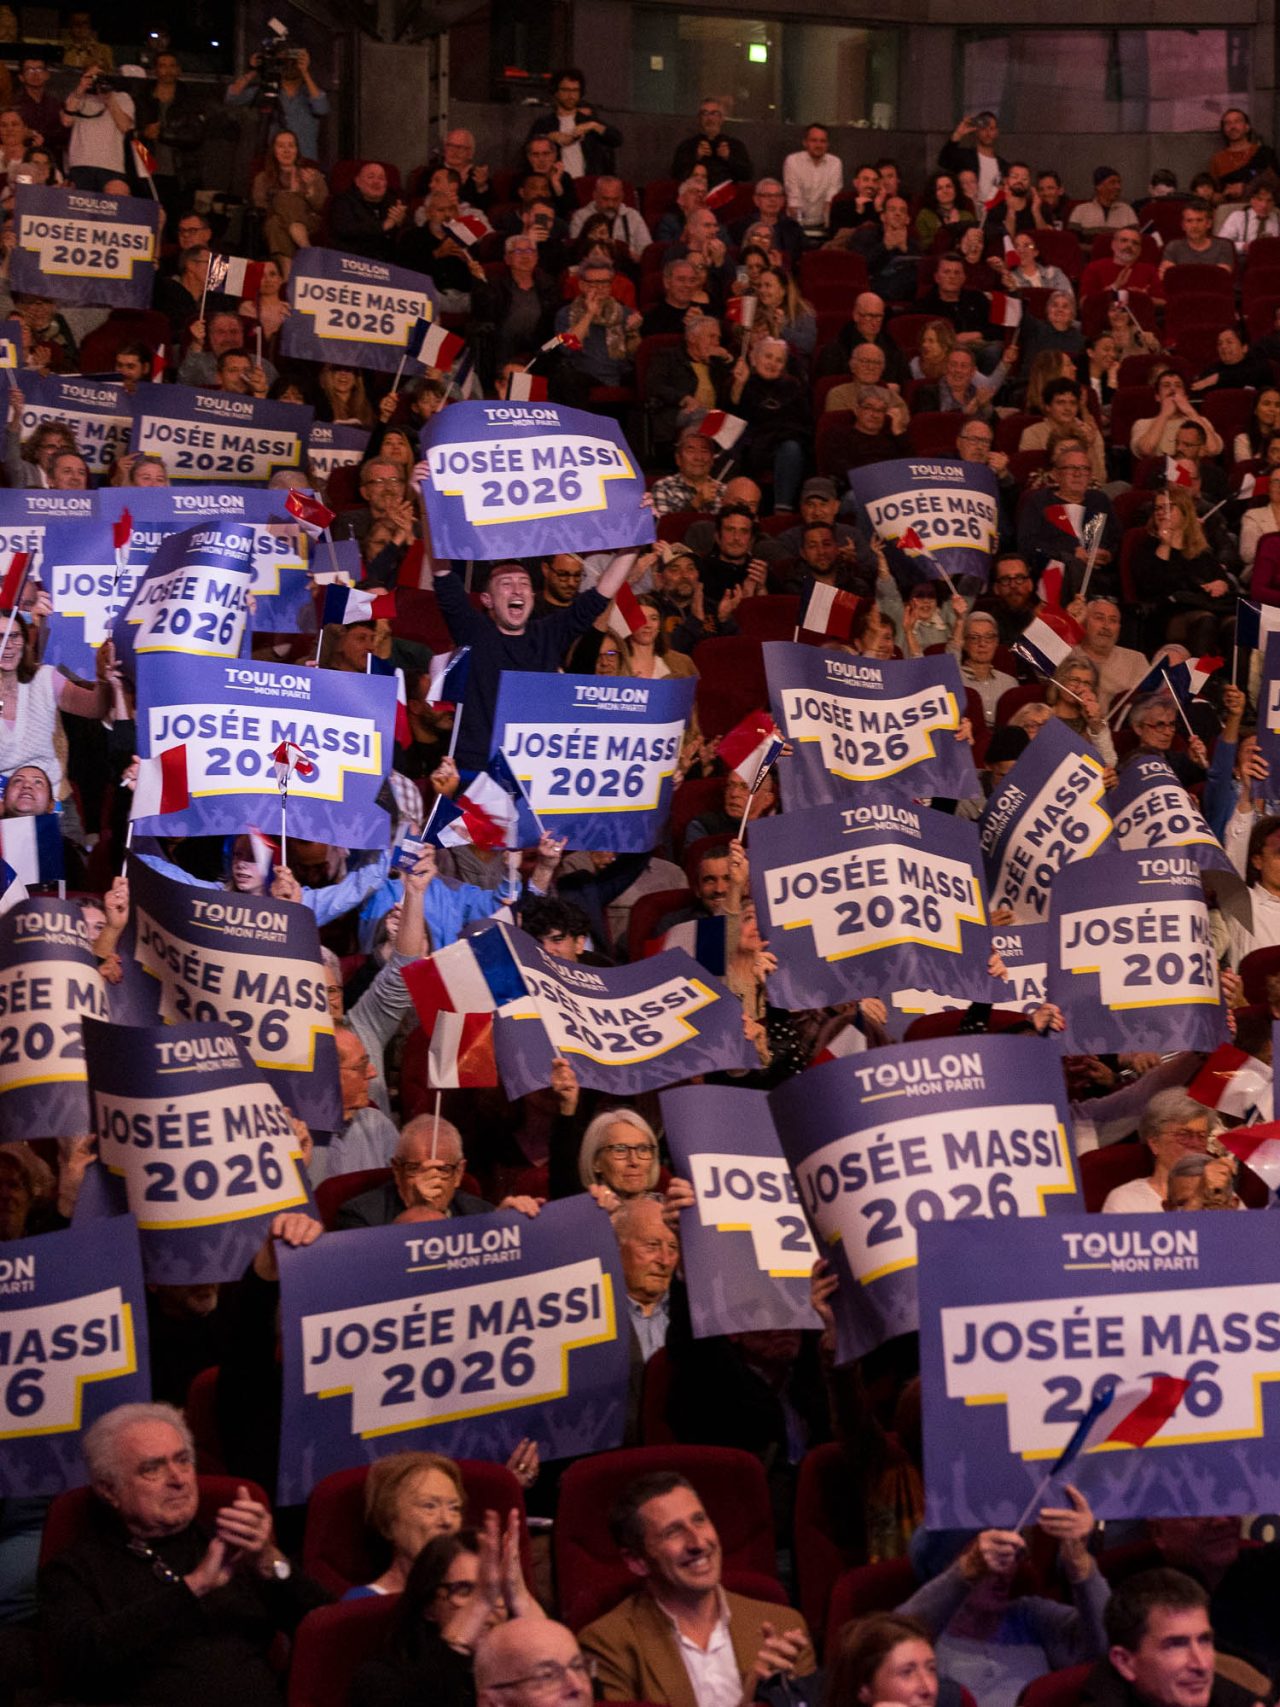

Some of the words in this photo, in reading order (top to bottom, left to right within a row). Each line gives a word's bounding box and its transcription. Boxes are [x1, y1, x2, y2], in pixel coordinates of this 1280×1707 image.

[23, 221, 87, 243] JOSÉE
[92, 227, 149, 250] MASSI
[53, 246, 119, 269] 2026
[341, 259, 390, 275] TOULON
[299, 282, 360, 306] JOSÉE
[366, 289, 426, 317] MASSI
[328, 309, 395, 334] 2026
[61, 384, 117, 401] TOULON
[195, 396, 254, 414] TOULON
[484, 408, 558, 421] TOULON
[144, 423, 214, 448] JOSÉE
[222, 434, 293, 457] MASSI
[176, 451, 255, 473] 2026
[435, 444, 523, 475] JOSÉE
[533, 447, 622, 471] MASSI
[908, 465, 964, 477] TOULON
[26, 497, 92, 511] TOULON
[172, 495, 244, 510] TOULON
[481, 470, 582, 507] 2026
[874, 492, 943, 526] JOSÉE
[911, 517, 981, 540] 2026
[138, 570, 198, 604] JOSÉE
[150, 607, 235, 645] 2026
[224, 668, 311, 692] TOULON
[825, 660, 883, 682] TOULON
[254, 686, 280, 697] MON
[574, 685, 649, 704] TOULON
[790, 697, 853, 732] JOSÉE
[860, 697, 948, 735] MASSI
[155, 709, 260, 742] JOSÉE
[271, 719, 370, 758] MASSI
[508, 727, 598, 759] JOSÉE
[832, 733, 909, 767] 2026
[549, 764, 644, 797] 2026
[840, 803, 920, 830] TOULON
[1024, 764, 1099, 848] MASSI
[874, 820, 898, 833] MON
[774, 855, 888, 905] JOSÉE
[897, 858, 976, 906] MASSI
[1025, 816, 1090, 915] 2026
[191, 900, 288, 932] TOULON
[833, 894, 942, 936] 2026
[1066, 908, 1180, 948] JOSÉE
[223, 925, 253, 942] MON
[255, 929, 287, 943] PARTI
[141, 928, 224, 995] JOSÉE
[589, 985, 699, 1028] MASSI
[559, 1011, 663, 1053] 2026
[155, 1037, 238, 1064] TOULON
[855, 1052, 984, 1092] TOULON
[904, 1081, 943, 1098] MON
[945, 1076, 986, 1093] PARTI
[101, 1105, 213, 1149] JOSÉE
[144, 1142, 283, 1203] 2026
[806, 1132, 933, 1215] JOSÉE
[942, 1128, 1062, 1171] MASSI
[861, 1172, 1019, 1249] 2026
[405, 1224, 521, 1263] TOULON
[447, 1257, 479, 1271] MON
[482, 1249, 521, 1267] PARTI
[1062, 1230, 1199, 1259] TOULON
[1110, 1257, 1149, 1272] MON
[1153, 1255, 1199, 1270] PARTI
[310, 1303, 454, 1365] JOSÉE
[468, 1283, 600, 1340] MASSI
[952, 1306, 1125, 1365] JOSÉE
[380, 1336, 536, 1407] 2026
[1042, 1359, 1223, 1424] 26
